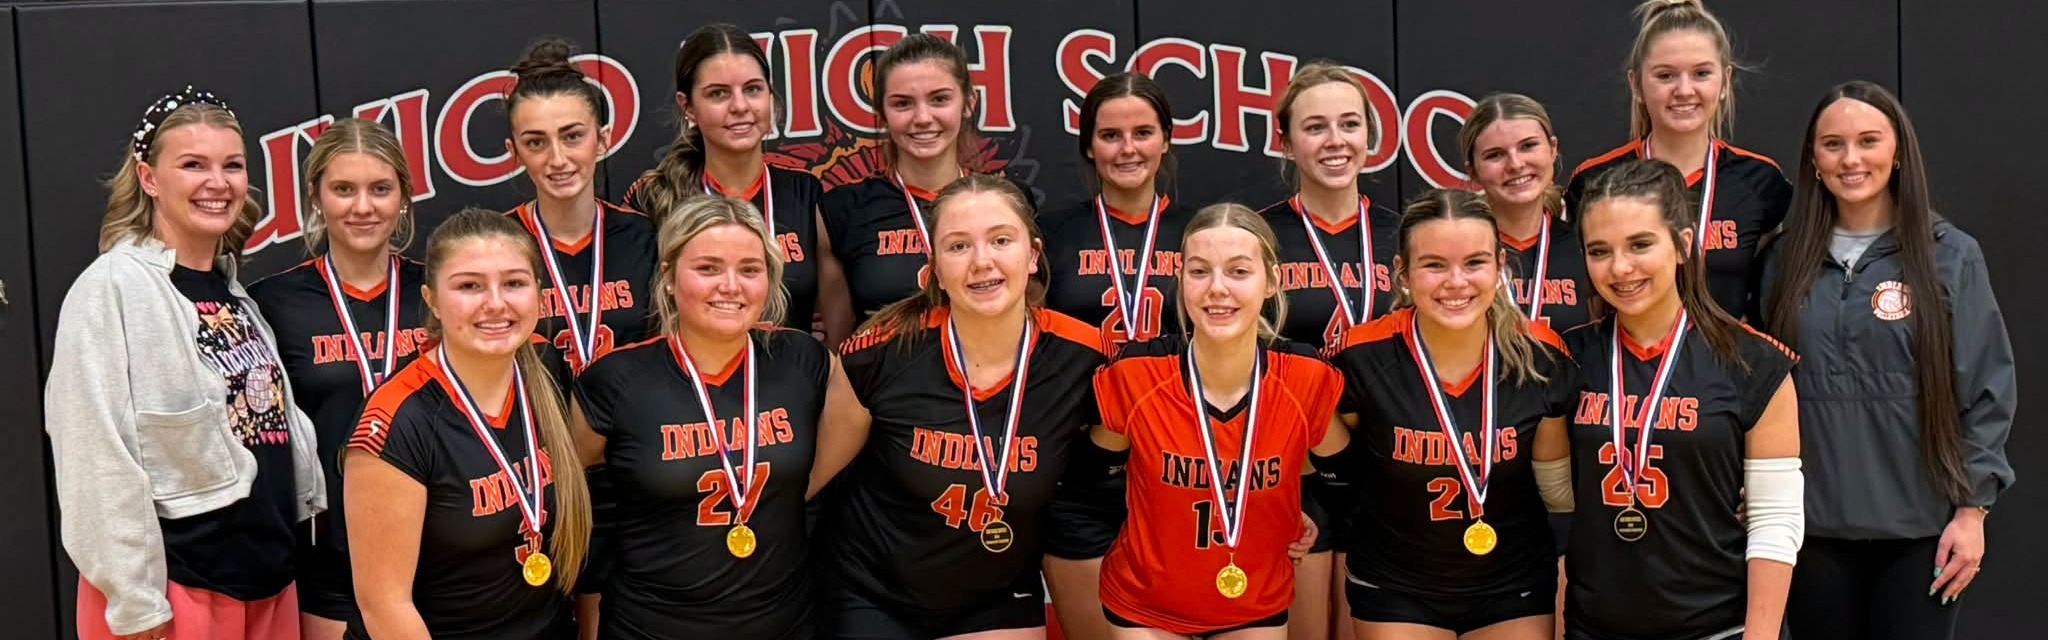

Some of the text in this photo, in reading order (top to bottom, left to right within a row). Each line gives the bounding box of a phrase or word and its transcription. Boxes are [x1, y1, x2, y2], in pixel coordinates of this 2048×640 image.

[680, 24, 1016, 139] IGH
[1056, 28, 1567, 222] SCHOO
[1078, 249, 1184, 276] ININS
[1279, 262, 1391, 292] INDAS
[1101, 286, 1164, 343] 20
[1161, 450, 1281, 492] INDANS
[1598, 441, 1669, 508] 25
[930, 483, 1009, 533] 46
